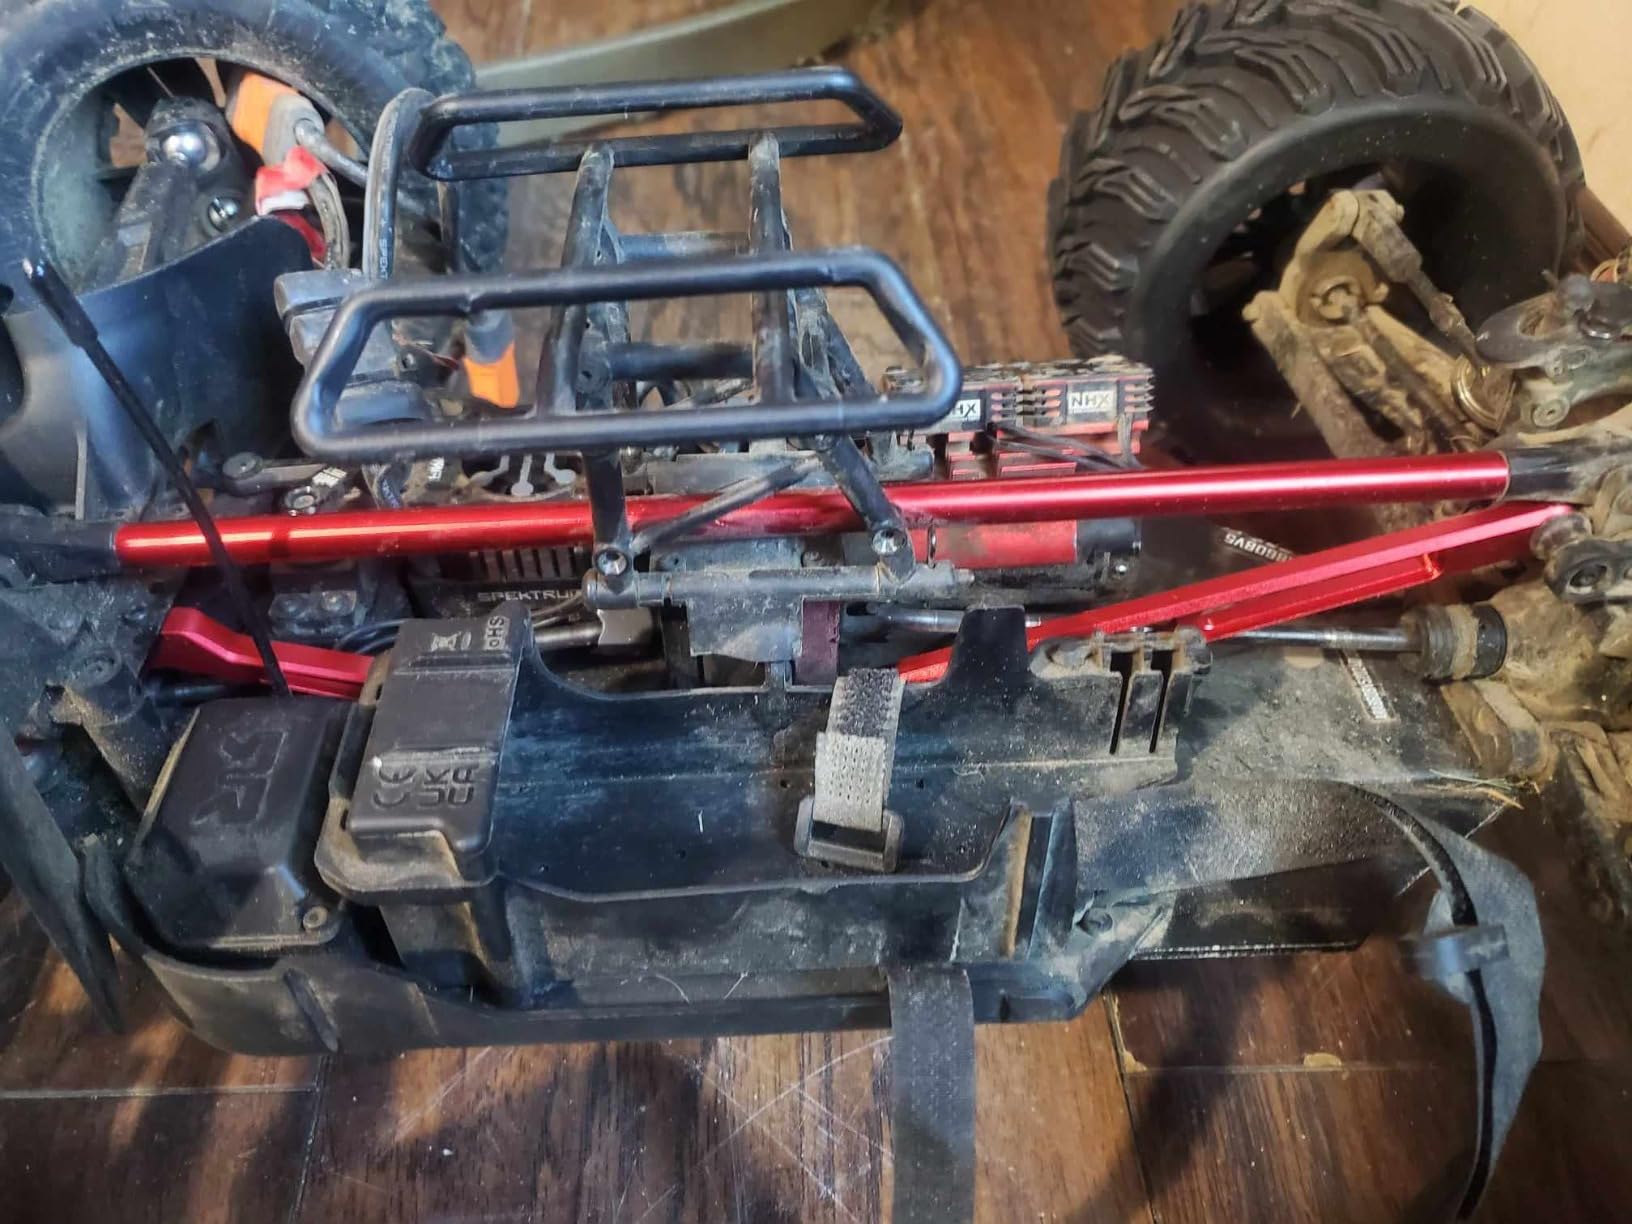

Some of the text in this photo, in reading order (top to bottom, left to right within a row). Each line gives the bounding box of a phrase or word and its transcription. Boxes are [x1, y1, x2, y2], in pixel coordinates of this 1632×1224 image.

[380, 239, 388, 280] SPEKT
[951, 402, 977, 418] HX
[1071, 391, 1110, 409] NHX
[1224, 532, 1293, 563] 8608V5
